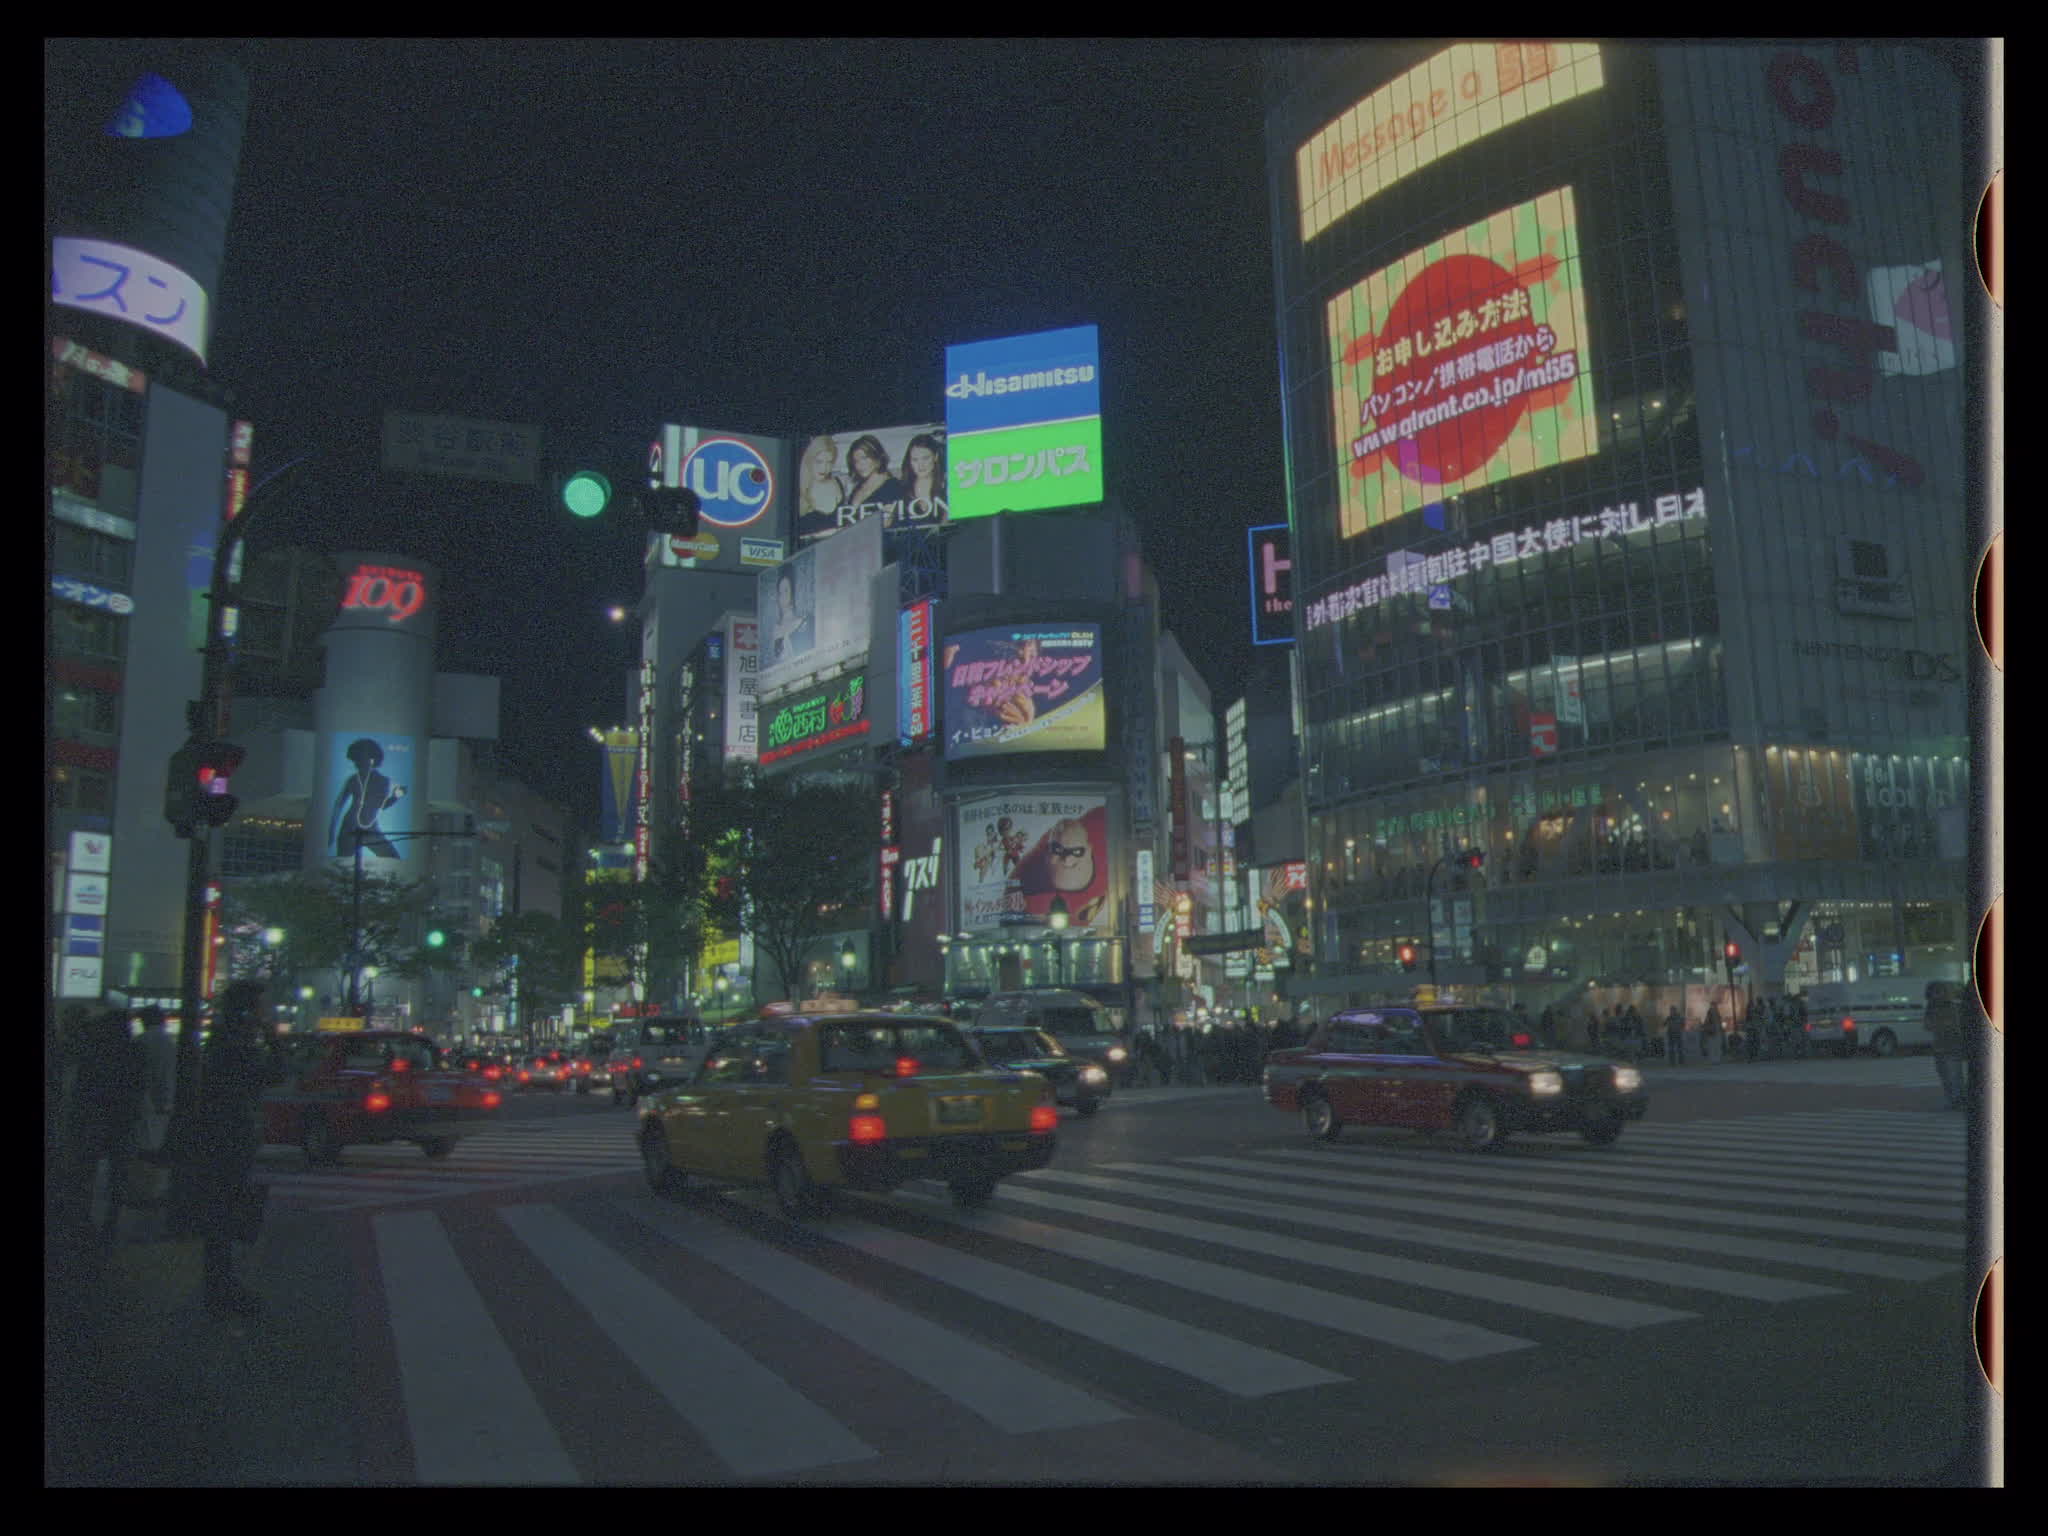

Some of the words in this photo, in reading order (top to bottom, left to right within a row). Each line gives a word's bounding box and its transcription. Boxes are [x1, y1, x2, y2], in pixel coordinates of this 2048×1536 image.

[1315, 88, 1448, 190] Message
[52, 255, 188, 326] スン
[1374, 290, 1529, 377] お申し込み方法
[946, 365, 1095, 400] Hisamitsu
[955, 445, 1091, 489] サロンパス
[748, 546, 776, 560] VISA
[337, 575, 425, 622] 109
[1902, 649, 1962, 684] DS
[738, 655, 760, 743] 旭屋書店
